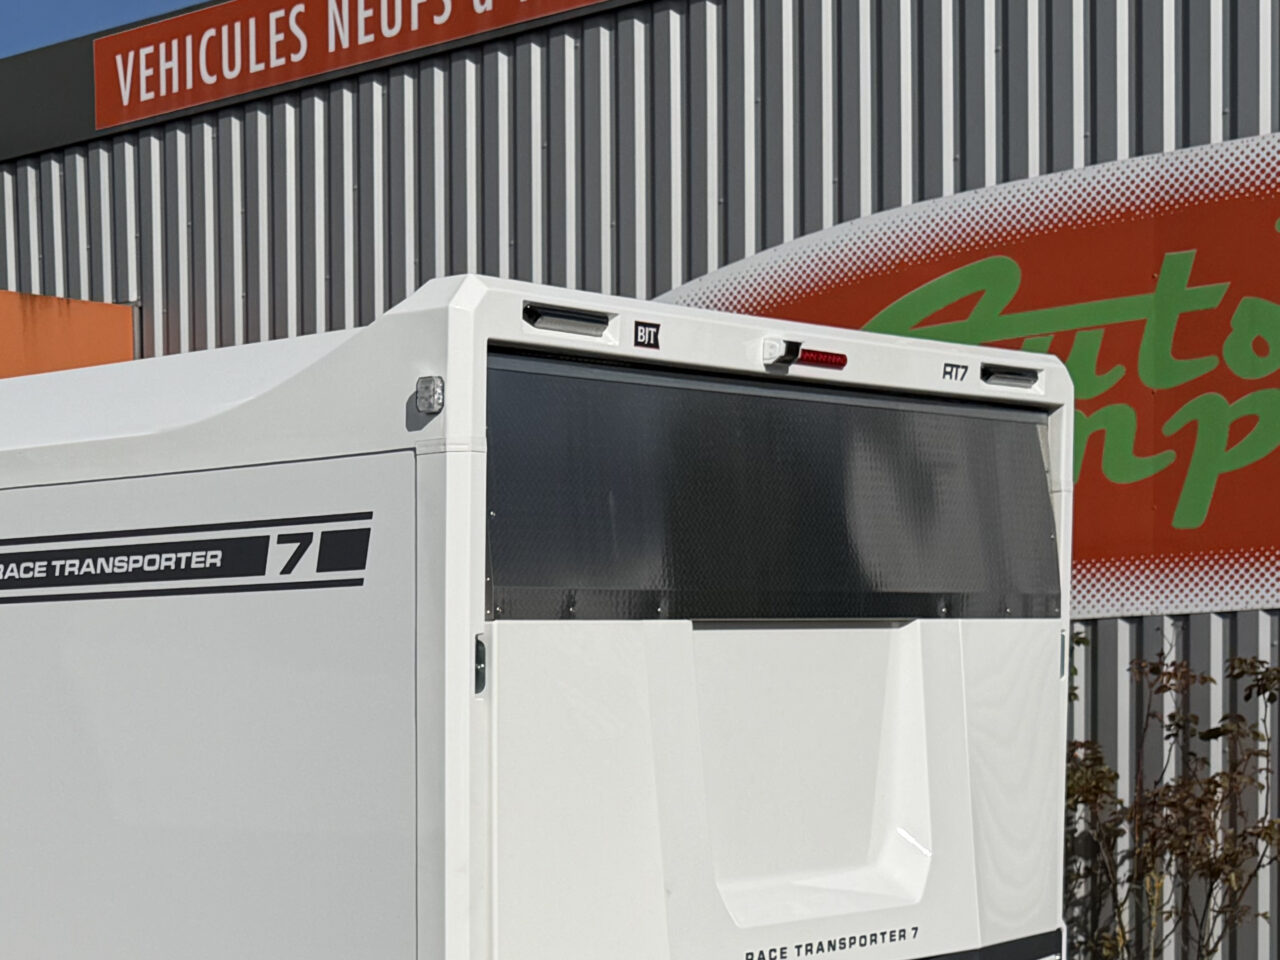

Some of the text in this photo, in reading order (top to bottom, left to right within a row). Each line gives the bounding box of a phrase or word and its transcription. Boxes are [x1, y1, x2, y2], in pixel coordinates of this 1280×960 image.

[115, 3, 309, 106] VEHICULES
[637, 325, 657, 345] BJT
[942, 362, 969, 382] RT7
[51, 549, 223, 577] TRANSPORTER
[275, 531, 315, 576] 7
[794, 929, 907, 958] TRANSPORTER
[911, 926, 919, 940] 7
